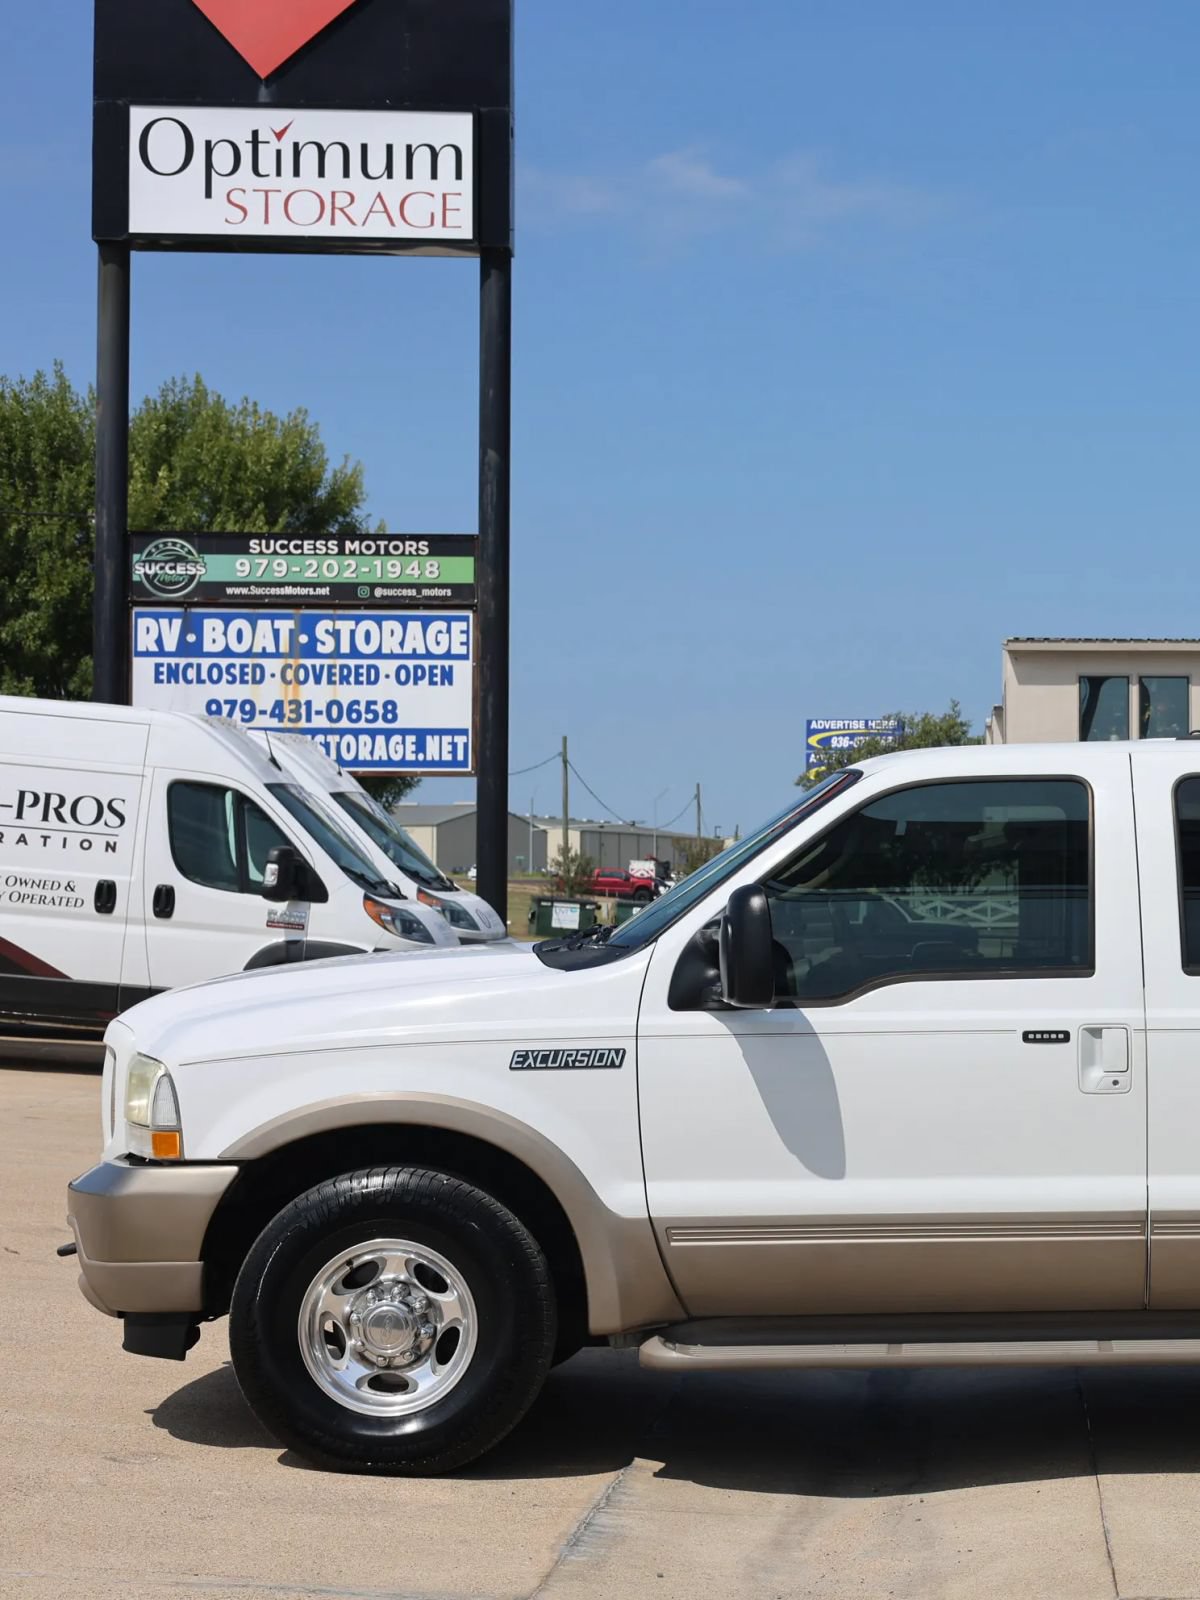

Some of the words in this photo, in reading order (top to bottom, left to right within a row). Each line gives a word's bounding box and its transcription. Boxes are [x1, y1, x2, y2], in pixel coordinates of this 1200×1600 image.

[138, 117, 463, 199] Optimum
[224, 187, 463, 229] STORAGE
[249, 539, 339, 555] SUCCESS
[344, 540, 430, 556] MOTORS
[134, 562, 206, 575] SUCCESS
[235, 558, 441, 578] 979-202-1948
[226, 585, 330, 596] www.SuccessMotors.net
[374, 586, 452, 598] @success_motors
[137, 618, 182, 653] RV
[203, 618, 295, 654] BOAT
[315, 619, 468, 656] STORAGE
[154, 662, 266, 685] ENCLOSED
[280, 663, 380, 686] COVERED
[394, 664, 454, 687] OPEN
[205, 699, 399, 724] 979-431-0658
[810, 719, 866, 730] ADVERTISE
[309, 733, 467, 762] STORAGE.NET
[5, 875, 61, 891] OWNED
[64, 880, 76, 893] &
[9, 890, 85, 908] OPERATED
[511, 1049, 624, 1068] EXCURSION
